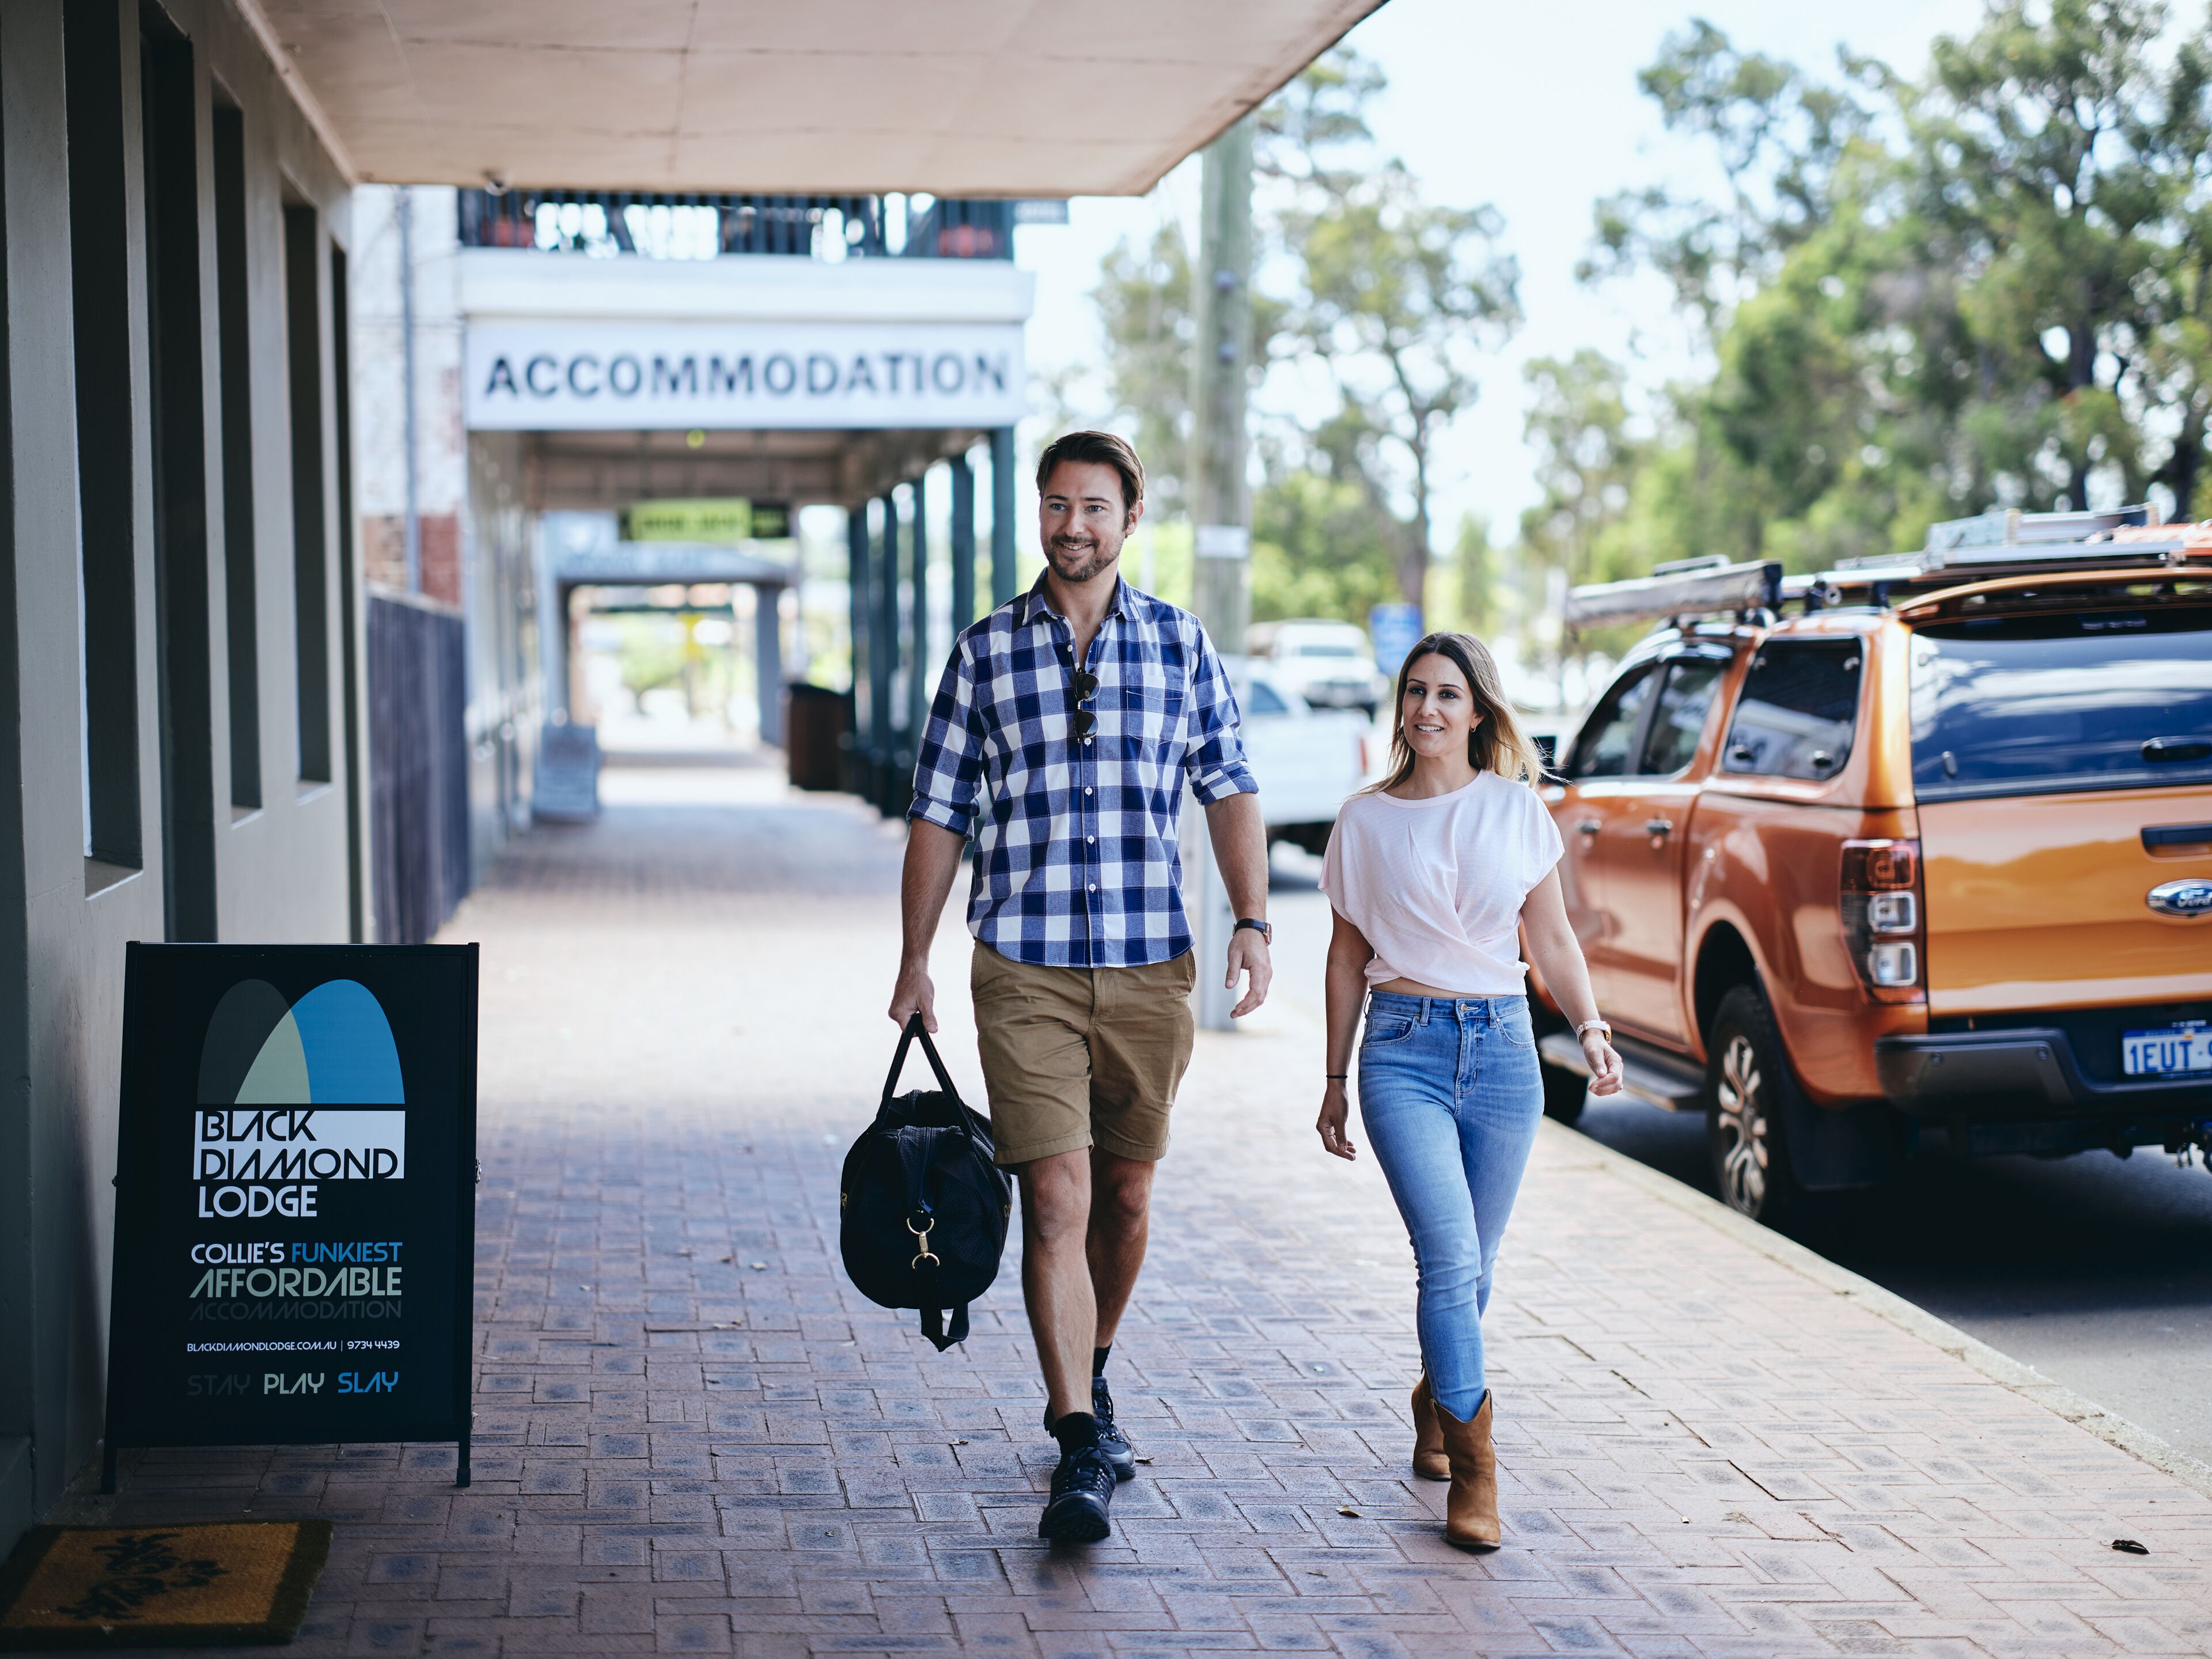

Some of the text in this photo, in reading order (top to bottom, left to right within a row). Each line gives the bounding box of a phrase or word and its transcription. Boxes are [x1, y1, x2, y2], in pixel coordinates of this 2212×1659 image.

[485, 353, 1008, 397] ACCOMMODATION
[201, 1111, 317, 1142] BLACK
[200, 1148, 399, 1180] DIAMOND
[199, 1185, 317, 1218] LODGE
[191, 1241, 403, 1264] COLLIE'S FUNKIEST
[189, 1267, 403, 1298] AFFORDABLE
[188, 1300, 402, 1321] ACCOMMODATION
[187, 1340, 400, 1352] BLACKDIAMONDLODGE.COM.AU 9734 4439
[187, 1372, 399, 1396] STAY PLAY SLAY
